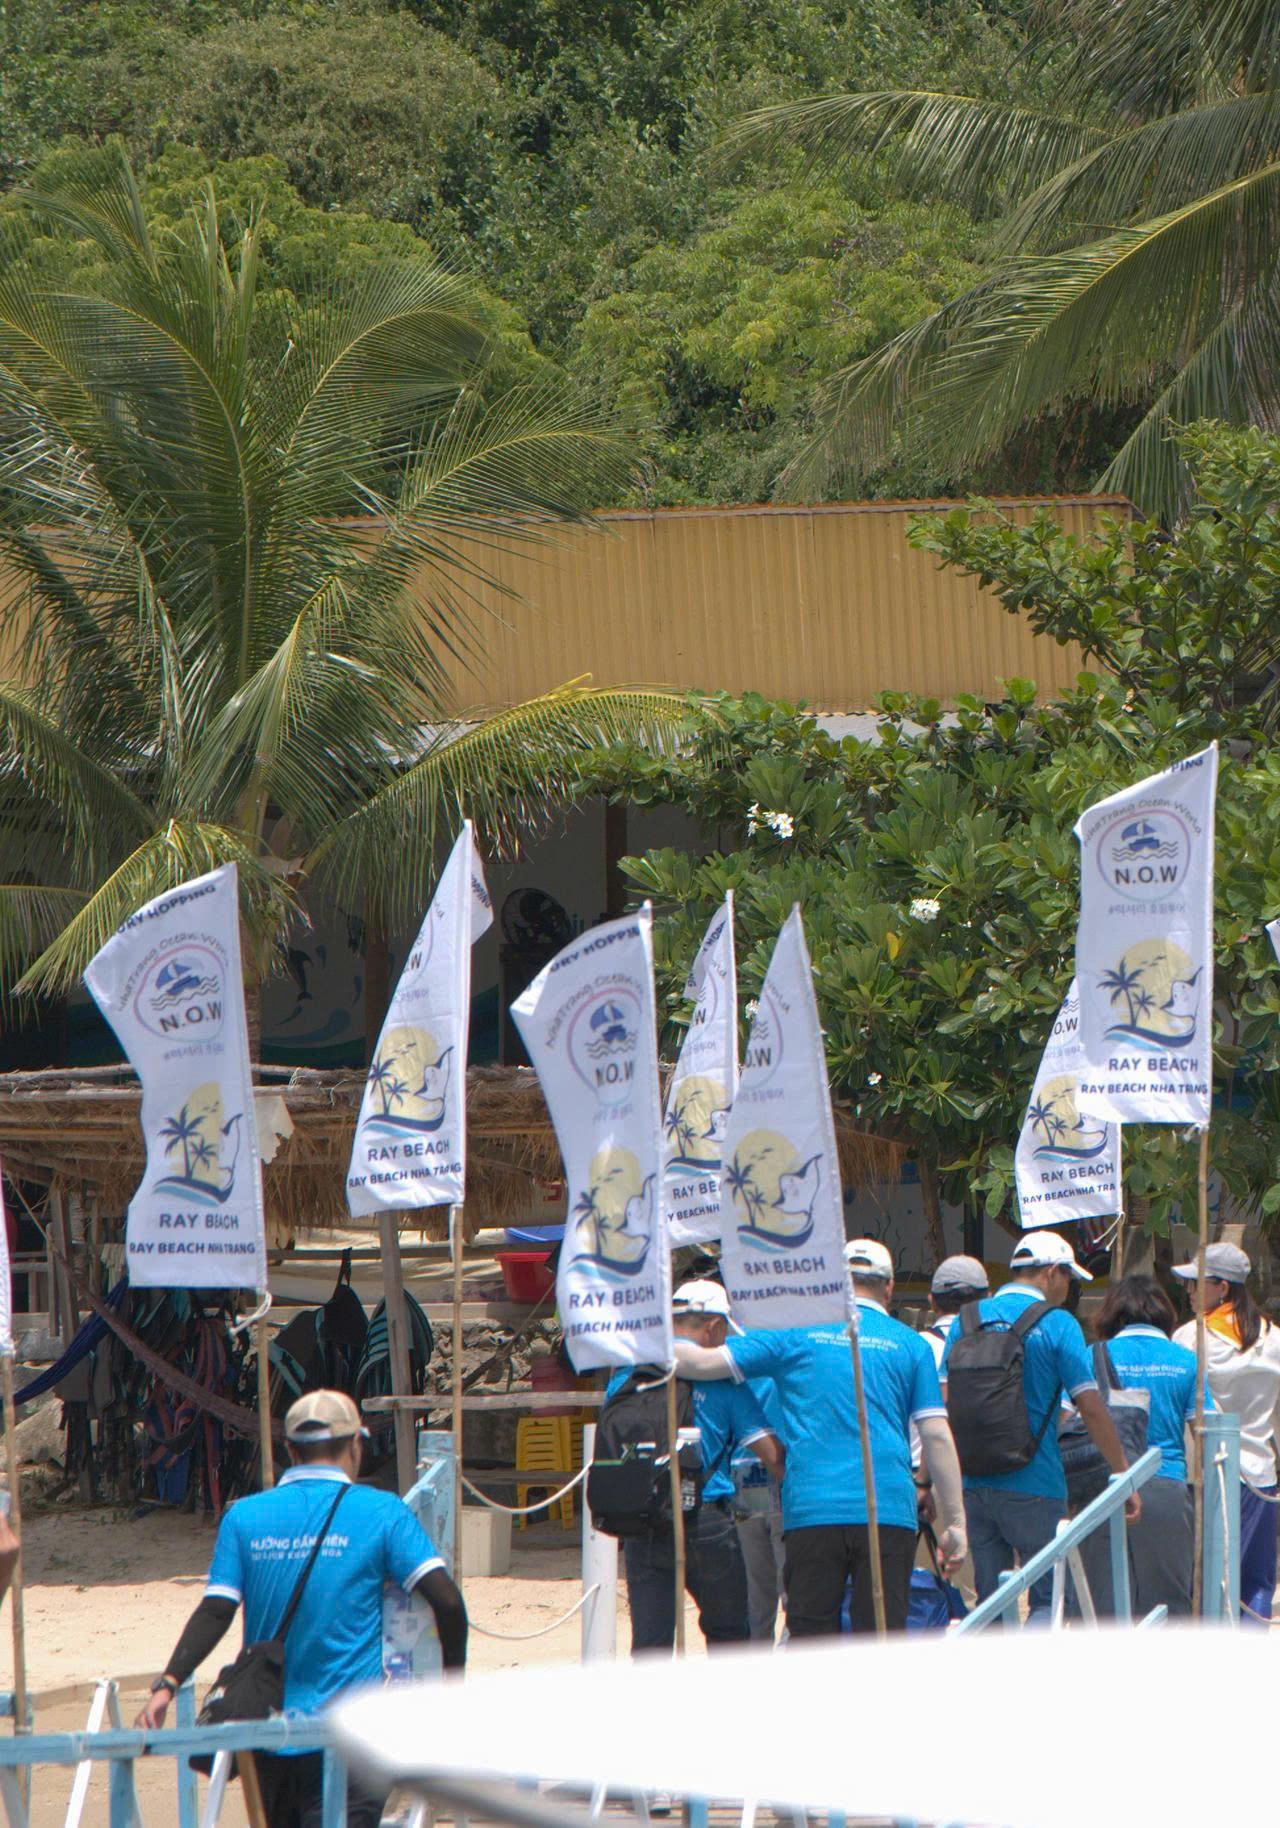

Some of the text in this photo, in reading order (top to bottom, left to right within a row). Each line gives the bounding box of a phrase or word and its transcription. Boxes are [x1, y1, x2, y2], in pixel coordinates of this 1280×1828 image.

[1114, 865, 1178, 885] N.O.W
[147, 884, 217, 920] HOPPING
[159, 1001, 223, 1033] N.O.W
[1053, 1017, 1079, 1036] O.W
[1109, 1058, 1198, 1071] RAY BEACH
[1081, 1084, 1105, 1094] RAY
[1107, 1083, 1146, 1094] BEACH
[1150, 1083, 1175, 1093] NHA
[368, 1140, 450, 1162] RAY BEACH
[349, 1176, 367, 1188] RAY
[370, 1171, 407, 1184] BEACH
[410, 1168, 431, 1179] NHA
[1041, 1163, 1114, 1183] RAY BEACH
[673, 1184, 694, 1200] RAY
[1023, 1183, 1116, 1204] RAY BEACH NHA TRA
[159, 1213, 239, 1229] RAY BEACH
[677, 1206, 705, 1221] BEACH
[706, 1203, 720, 1214] NH
[129, 1242, 154, 1254] RAY
[158, 1242, 205, 1254] BEACH
[224, 1243, 256, 1254] TRANG
[744, 1256, 826, 1276] RAY BEACH
[569, 1285, 656, 1309] RAY BEACH
[731, 1289, 751, 1302] RAY
[753, 1286, 785, 1300] BEACH
[571, 1315, 664, 1337] BEACH NHA TRAN
